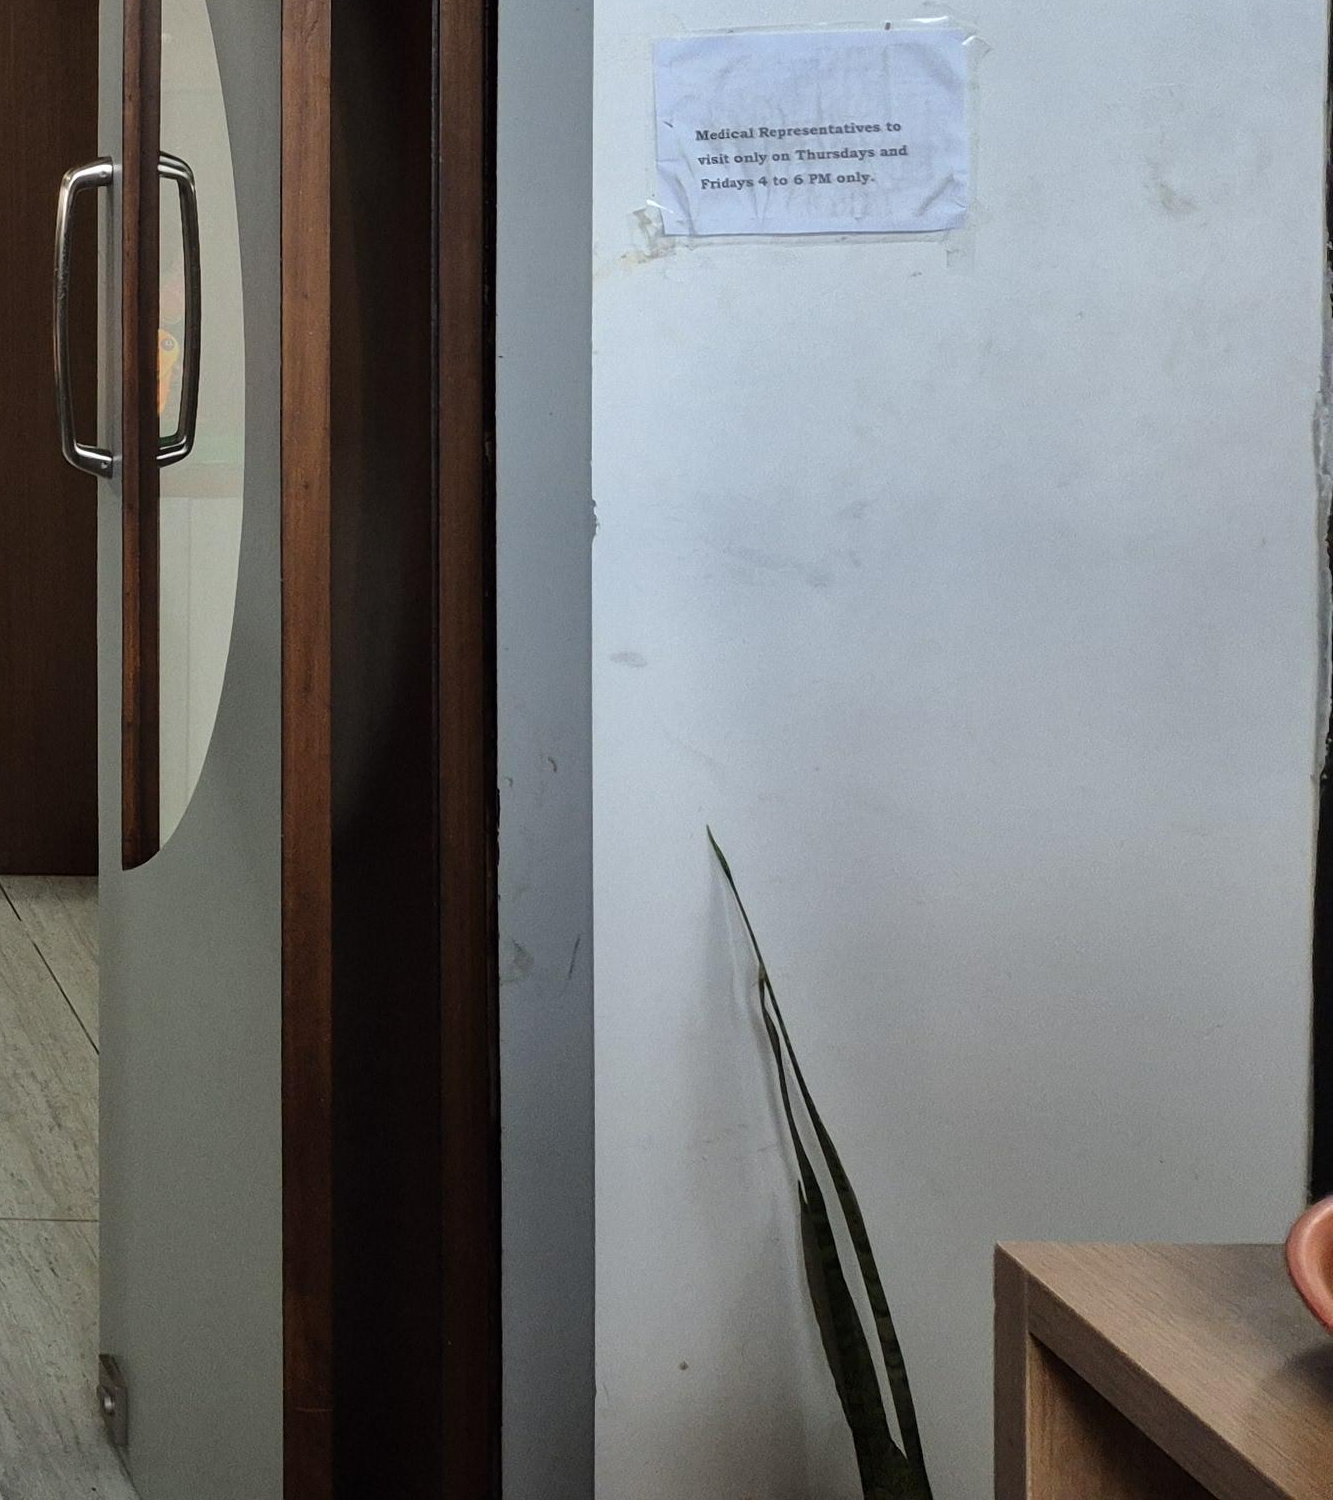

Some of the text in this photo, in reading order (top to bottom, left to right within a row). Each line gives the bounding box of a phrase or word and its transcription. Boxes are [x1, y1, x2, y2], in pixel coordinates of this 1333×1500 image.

[696, 122, 901, 140] Medical Representatives to
[698, 145, 908, 165] visit only on Thursdays and
[701, 172, 875, 190] Fridays 4 to 6 PM only.
